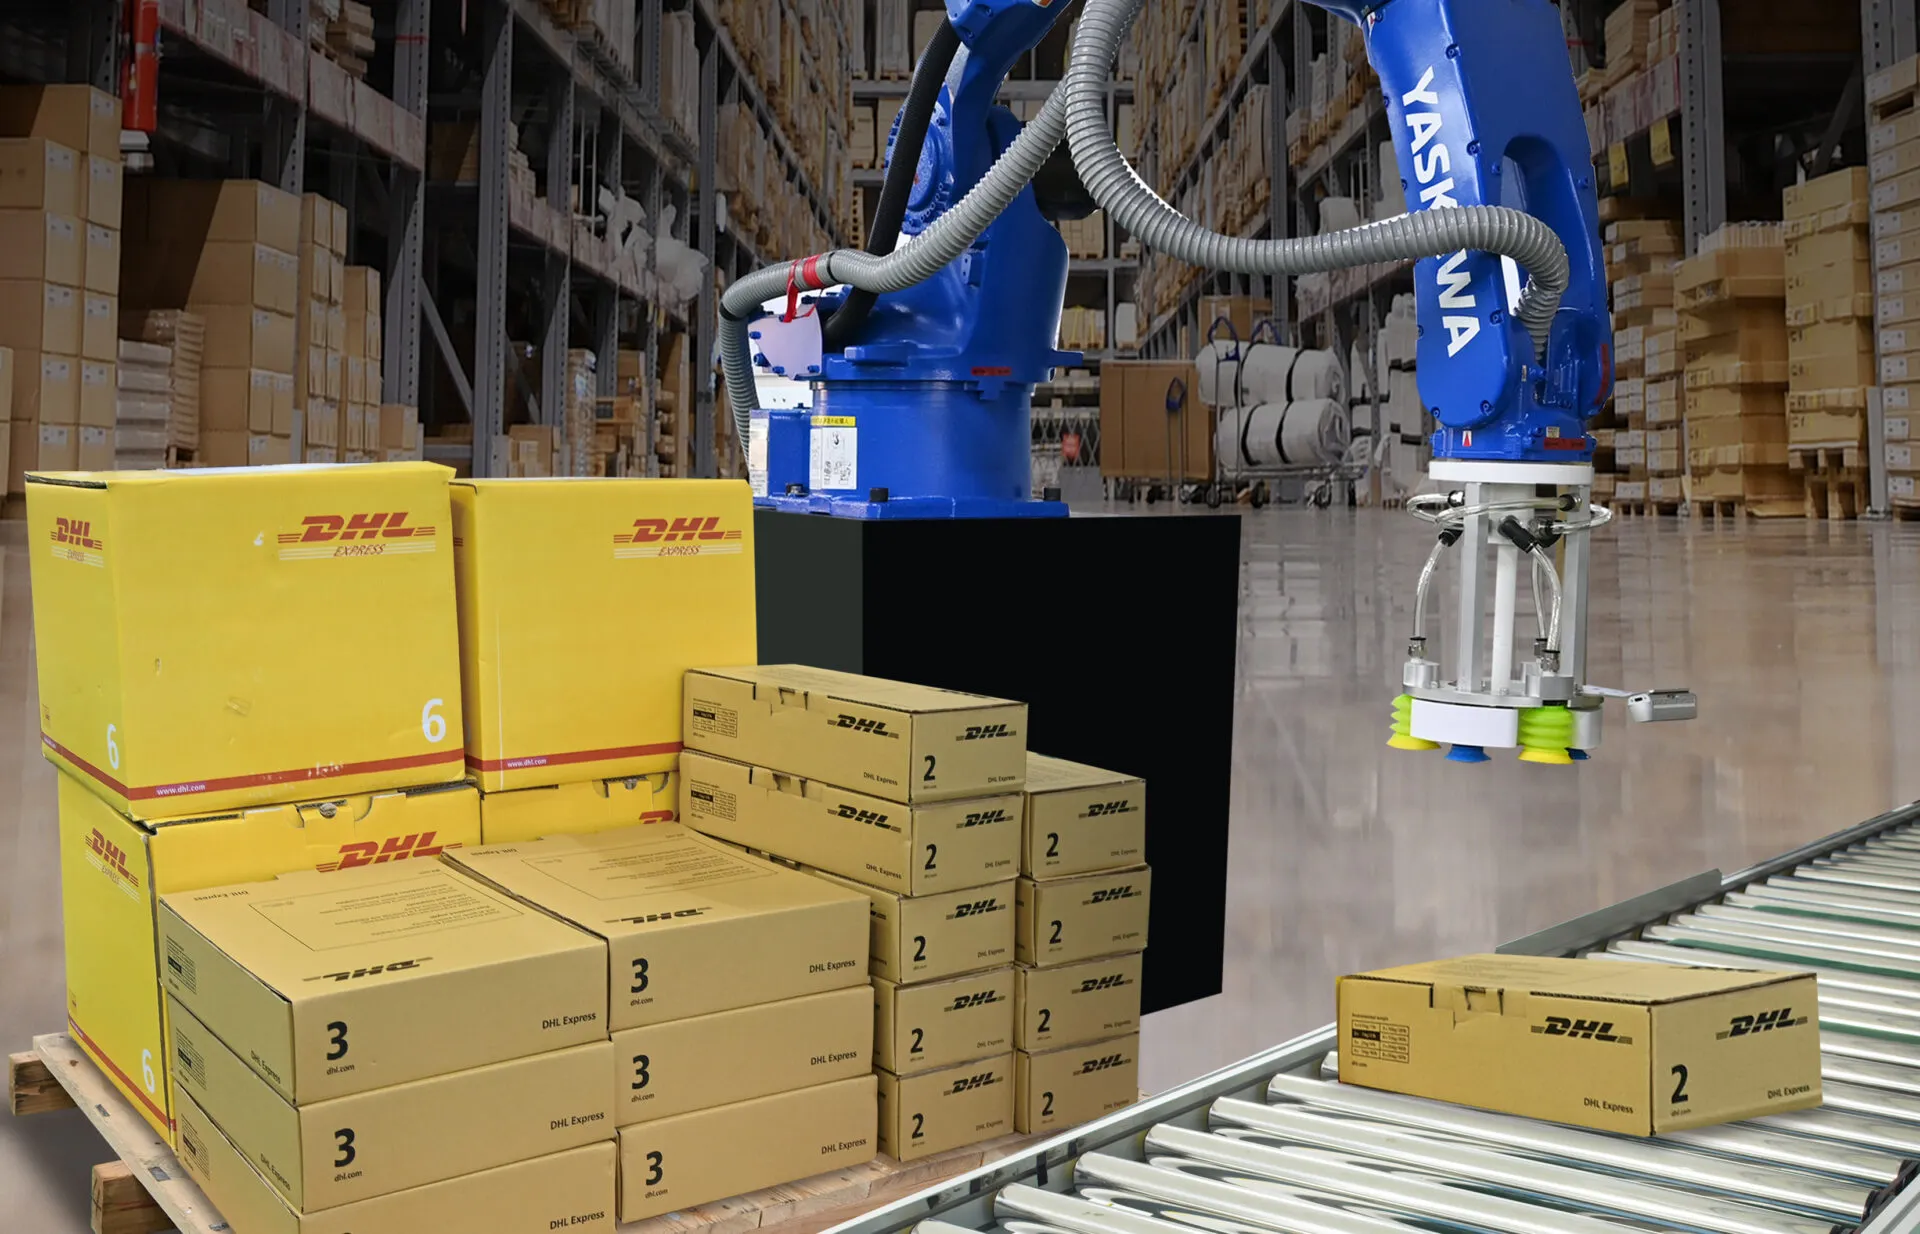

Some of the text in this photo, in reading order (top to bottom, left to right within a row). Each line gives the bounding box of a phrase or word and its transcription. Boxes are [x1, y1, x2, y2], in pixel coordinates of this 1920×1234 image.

[1402, 65, 1480, 358] YASKWA
[56, 517, 94, 549] DHL
[300, 512, 416, 543] DHL
[632, 517, 726, 543] DHL
[333, 544, 387, 557] EXPRESS
[658, 545, 702, 557] EXPRESS
[422, 698, 447, 743] 6
[837, 714, 889, 737] DHL
[964, 723, 1009, 741] DHL
[107, 723, 120, 770] 6
[507, 757, 548, 769] www.dhl.com
[923, 755, 936, 782] 2
[156, 782, 206, 797] www.dhl.com
[876, 774, 898, 787] Express
[837, 803, 891, 830] DHL
[964, 809, 1006, 827] DHL
[1087, 800, 1130, 817] DHL
[92, 827, 130, 880] DHL
[338, 831, 444, 870] DHL
[1046, 832, 1059, 858] 2
[924, 844, 937, 871] 2
[1090, 885, 1134, 904] DHL
[621, 908, 704, 925] DHL
[954, 898, 998, 919] DHL
[1049, 920, 1062, 945] 2
[913, 935, 926, 962] 2
[321, 959, 421, 983] DHL
[630, 957, 649, 994] 3
[808, 959, 856, 974] DHL Express
[1081, 973, 1125, 993] DHL
[953, 990, 998, 1010] DHL
[542, 1012, 597, 1030] DHL Express
[1037, 1008, 1051, 1033] 2
[1543, 1016, 1619, 1043] DHL
[1728, 1007, 1797, 1038] DHL
[326, 1021, 349, 1060] 3
[910, 1028, 924, 1054] 2
[326, 1063, 355, 1076] dhl.com
[810, 1050, 857, 1066] DHL Express
[1081, 1053, 1124, 1074] DHL
[142, 1049, 155, 1094] 6
[631, 1054, 650, 1090] 3
[952, 1071, 996, 1094] DHL
[1671, 1064, 1689, 1104] 2
[1767, 1084, 1810, 1099] DHL Express
[631, 1092, 655, 1103] dhl.com
[1041, 1091, 1054, 1117] 2
[1583, 1097, 1634, 1115] DHL Express
[550, 1111, 605, 1130] DHL Express
[911, 1113, 924, 1139] 2
[334, 1128, 356, 1168] 3
[821, 1137, 867, 1155] DHL Express
[334, 1169, 363, 1182] dhl.com
[645, 1150, 663, 1186] 3
[645, 1187, 668, 1199] dhl.com
[550, 1210, 605, 1230] DHL Express
